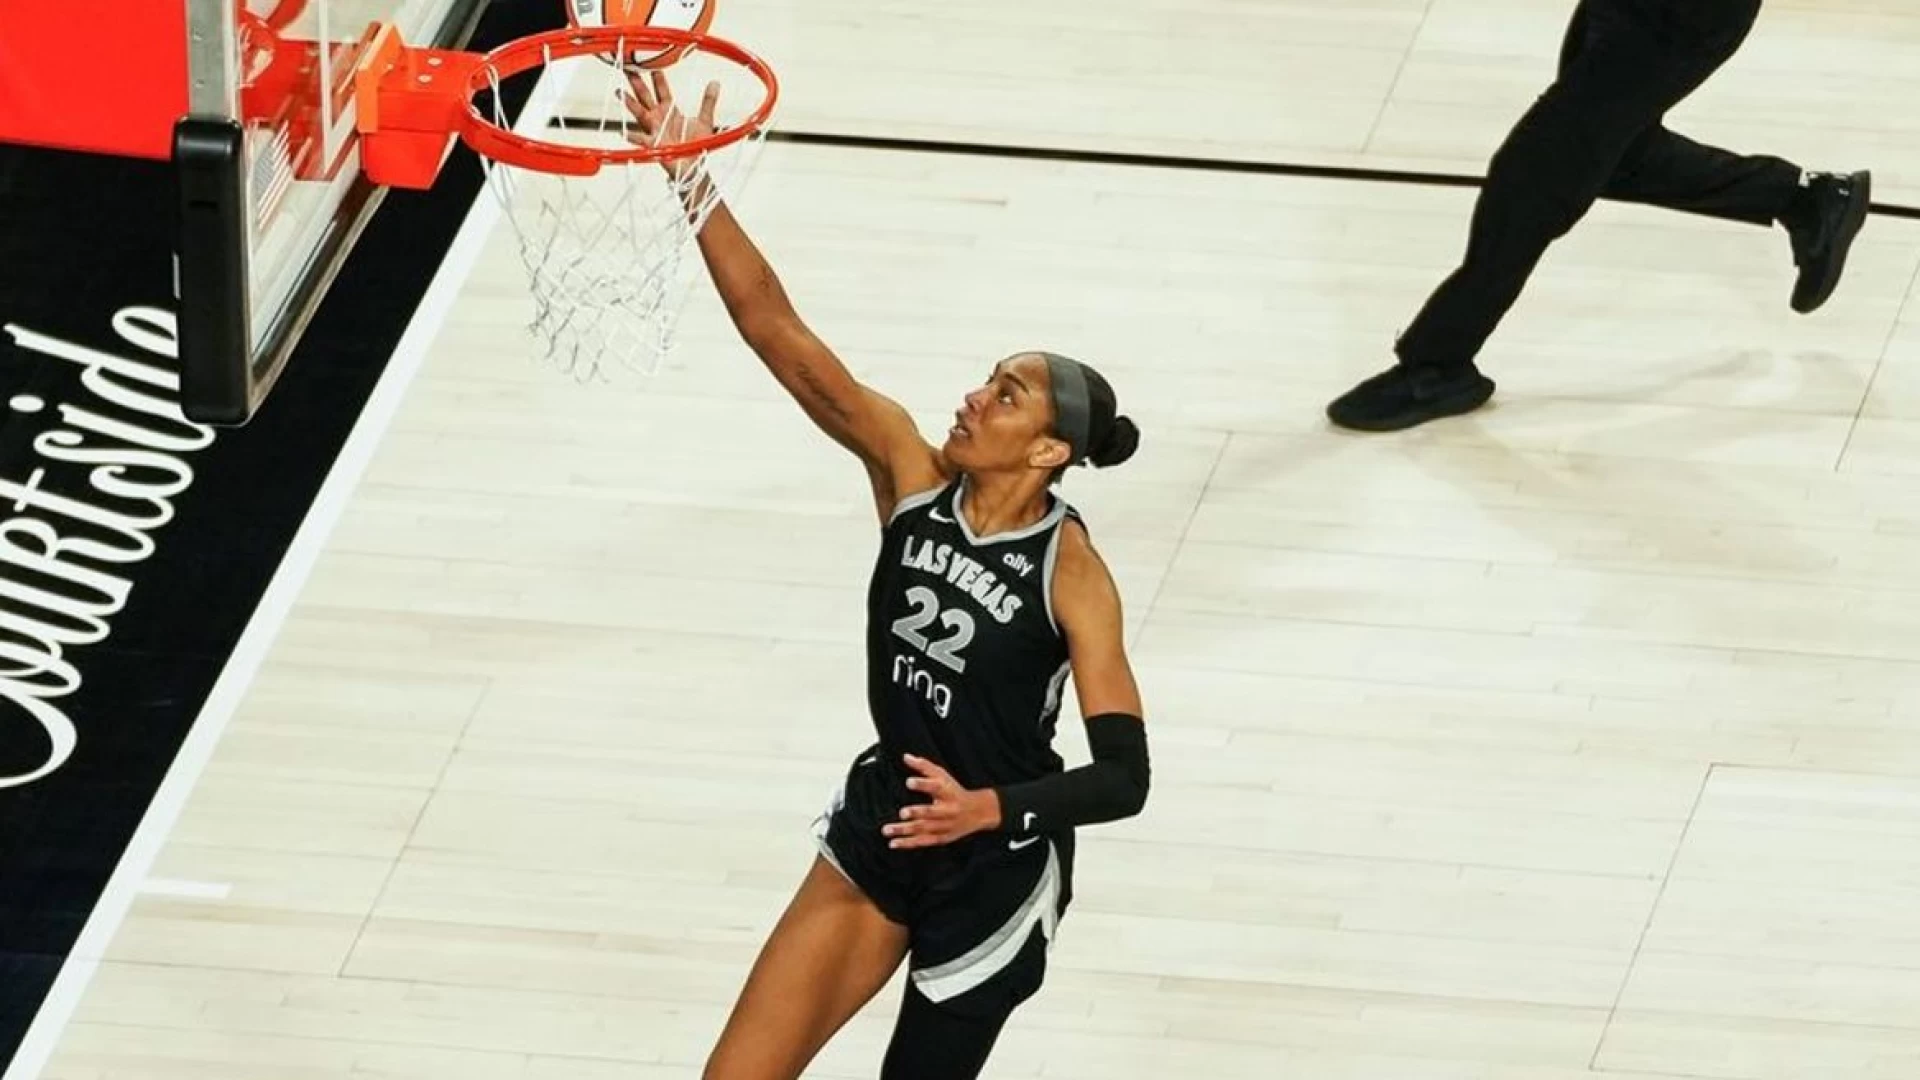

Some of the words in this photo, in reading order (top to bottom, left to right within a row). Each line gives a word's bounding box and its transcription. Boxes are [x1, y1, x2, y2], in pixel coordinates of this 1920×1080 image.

[901, 535, 953, 574] LAS
[947, 552, 1023, 624] VEGAS
[1003, 552, 1034, 577] ally
[891, 586, 975, 673] 22
[893, 655, 951, 718] ring
